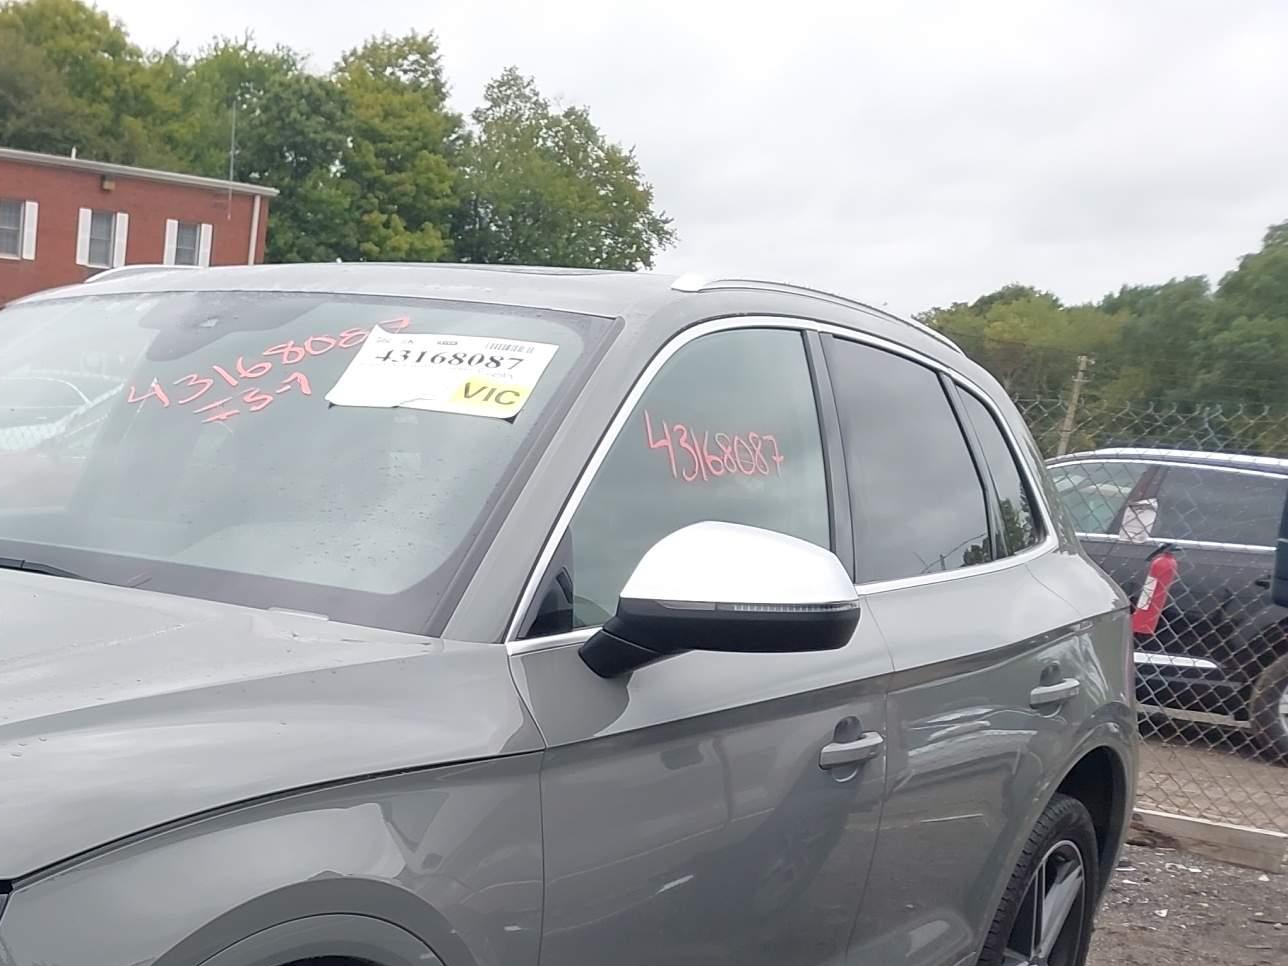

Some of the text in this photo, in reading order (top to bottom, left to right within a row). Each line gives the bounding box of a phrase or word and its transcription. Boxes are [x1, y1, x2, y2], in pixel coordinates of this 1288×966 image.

[375, 349, 525, 371] 43168087
[463, 382, 521, 406] VIC
[643, 408, 785, 482] 43168087
